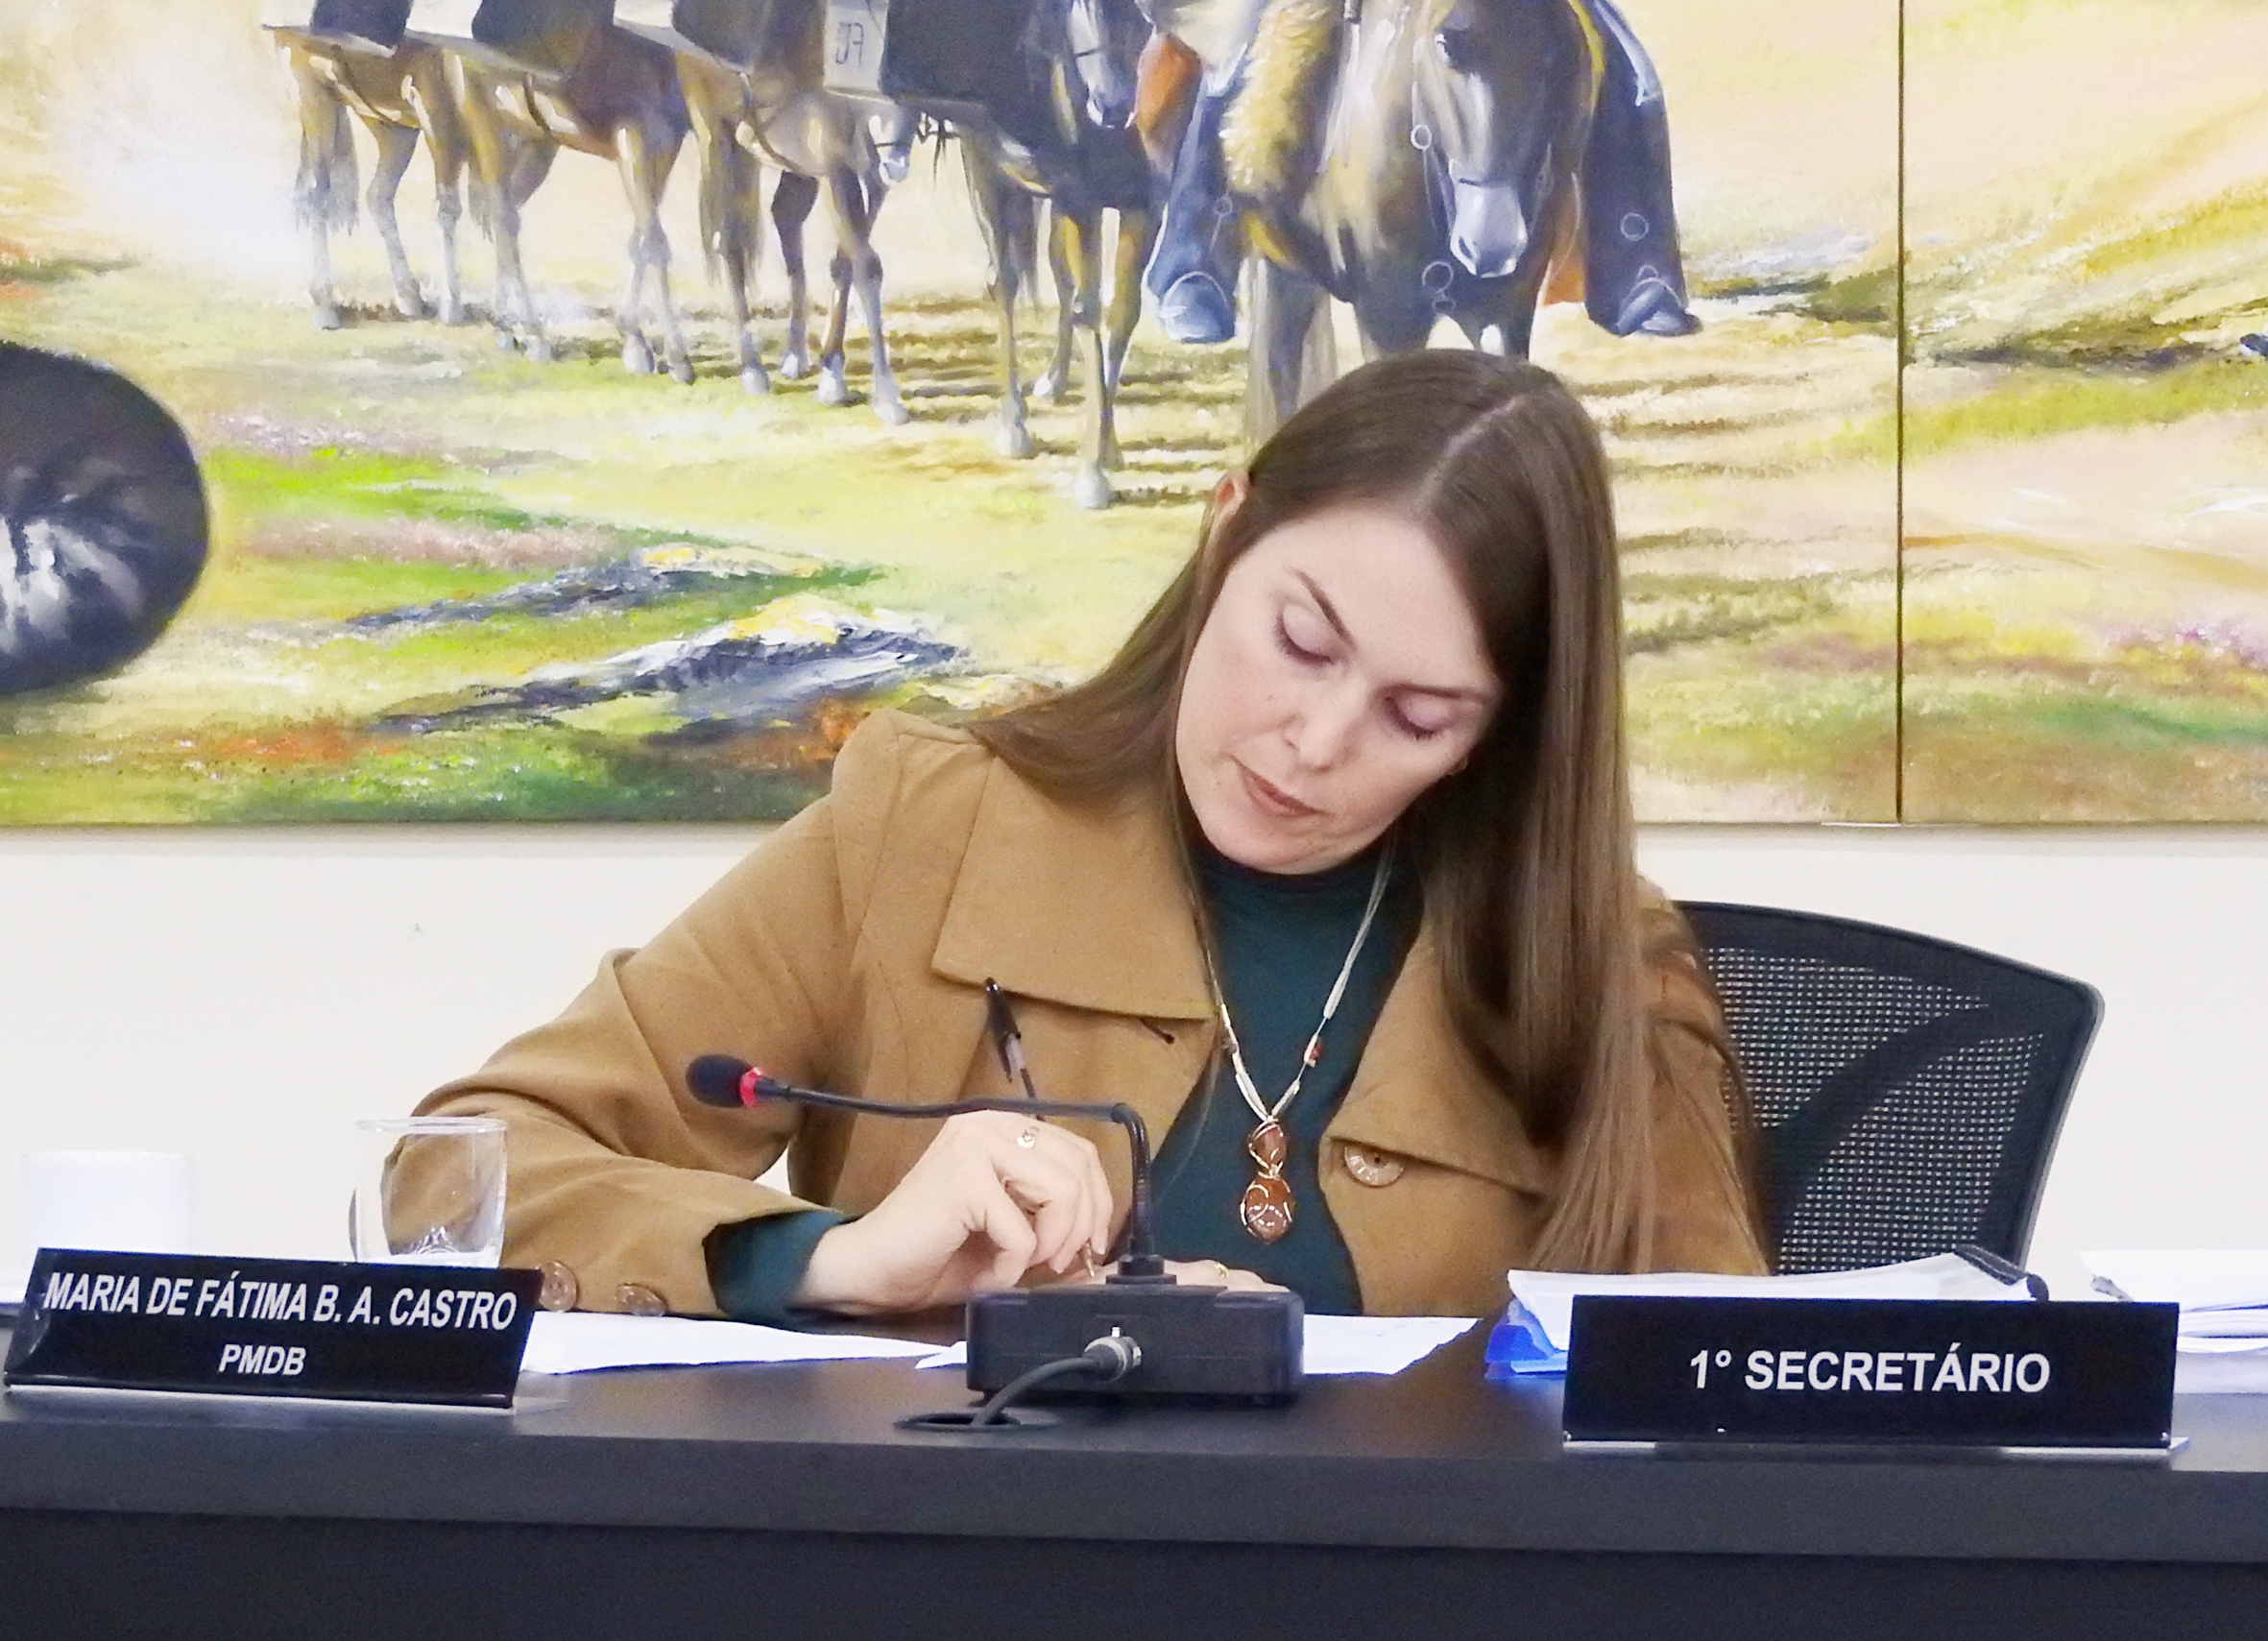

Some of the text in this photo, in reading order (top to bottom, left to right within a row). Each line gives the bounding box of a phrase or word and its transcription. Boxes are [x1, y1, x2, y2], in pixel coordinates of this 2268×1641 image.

[42, 1270, 518, 1330] MARIA DE FÁTIMA B. A. CASTRO
[218, 1343, 306, 1376] PMDB
[1745, 1341, 2050, 1393] SECRETÁRIO
